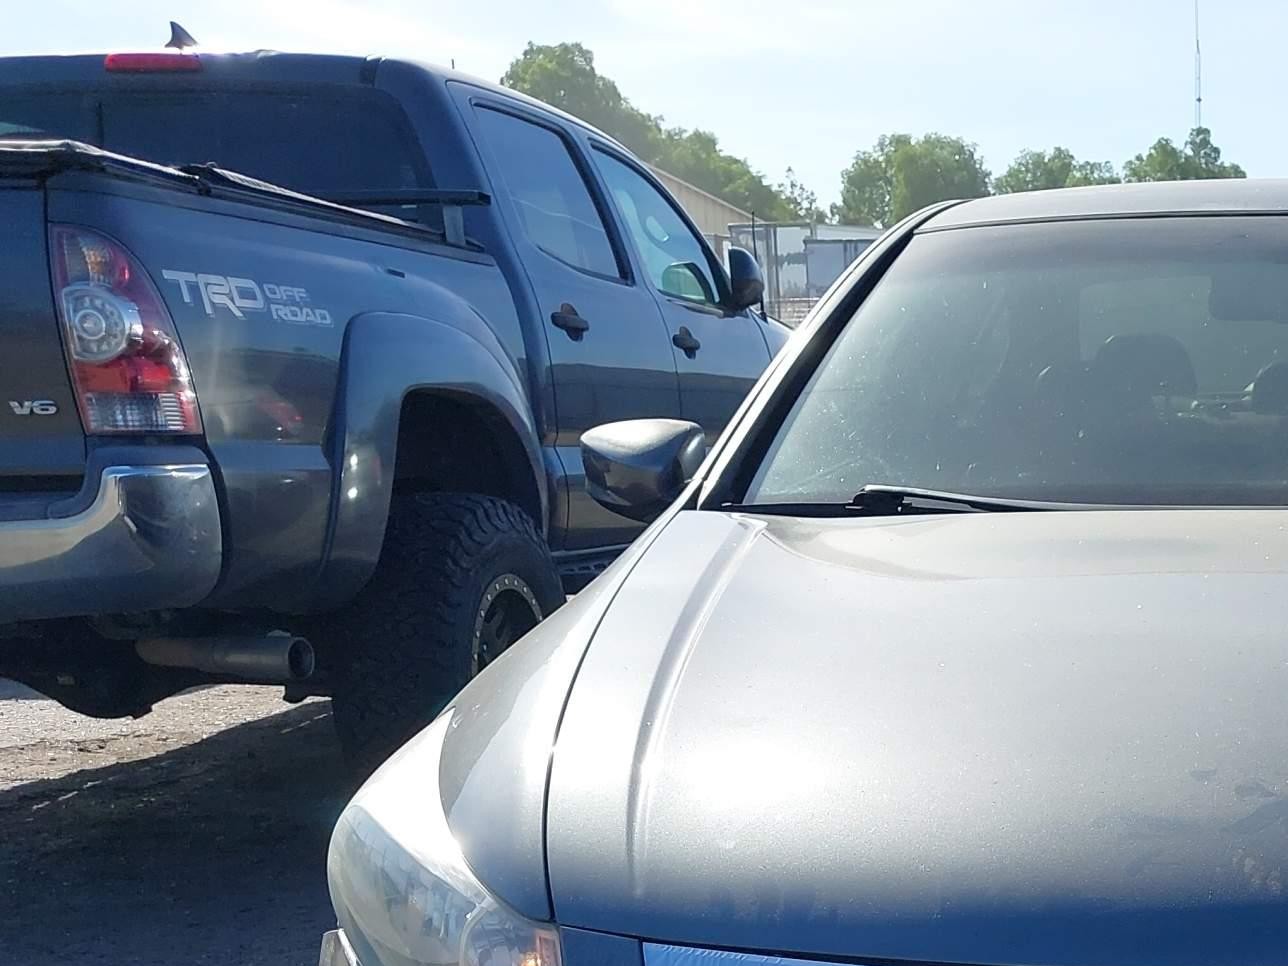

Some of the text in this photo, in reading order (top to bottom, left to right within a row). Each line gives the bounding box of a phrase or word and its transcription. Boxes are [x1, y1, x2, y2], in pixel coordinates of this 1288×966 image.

[162, 269, 267, 321] TRD
[264, 283, 311, 301] OFF
[269, 304, 334, 328] ROAD
[8, 400, 58, 416] V6
